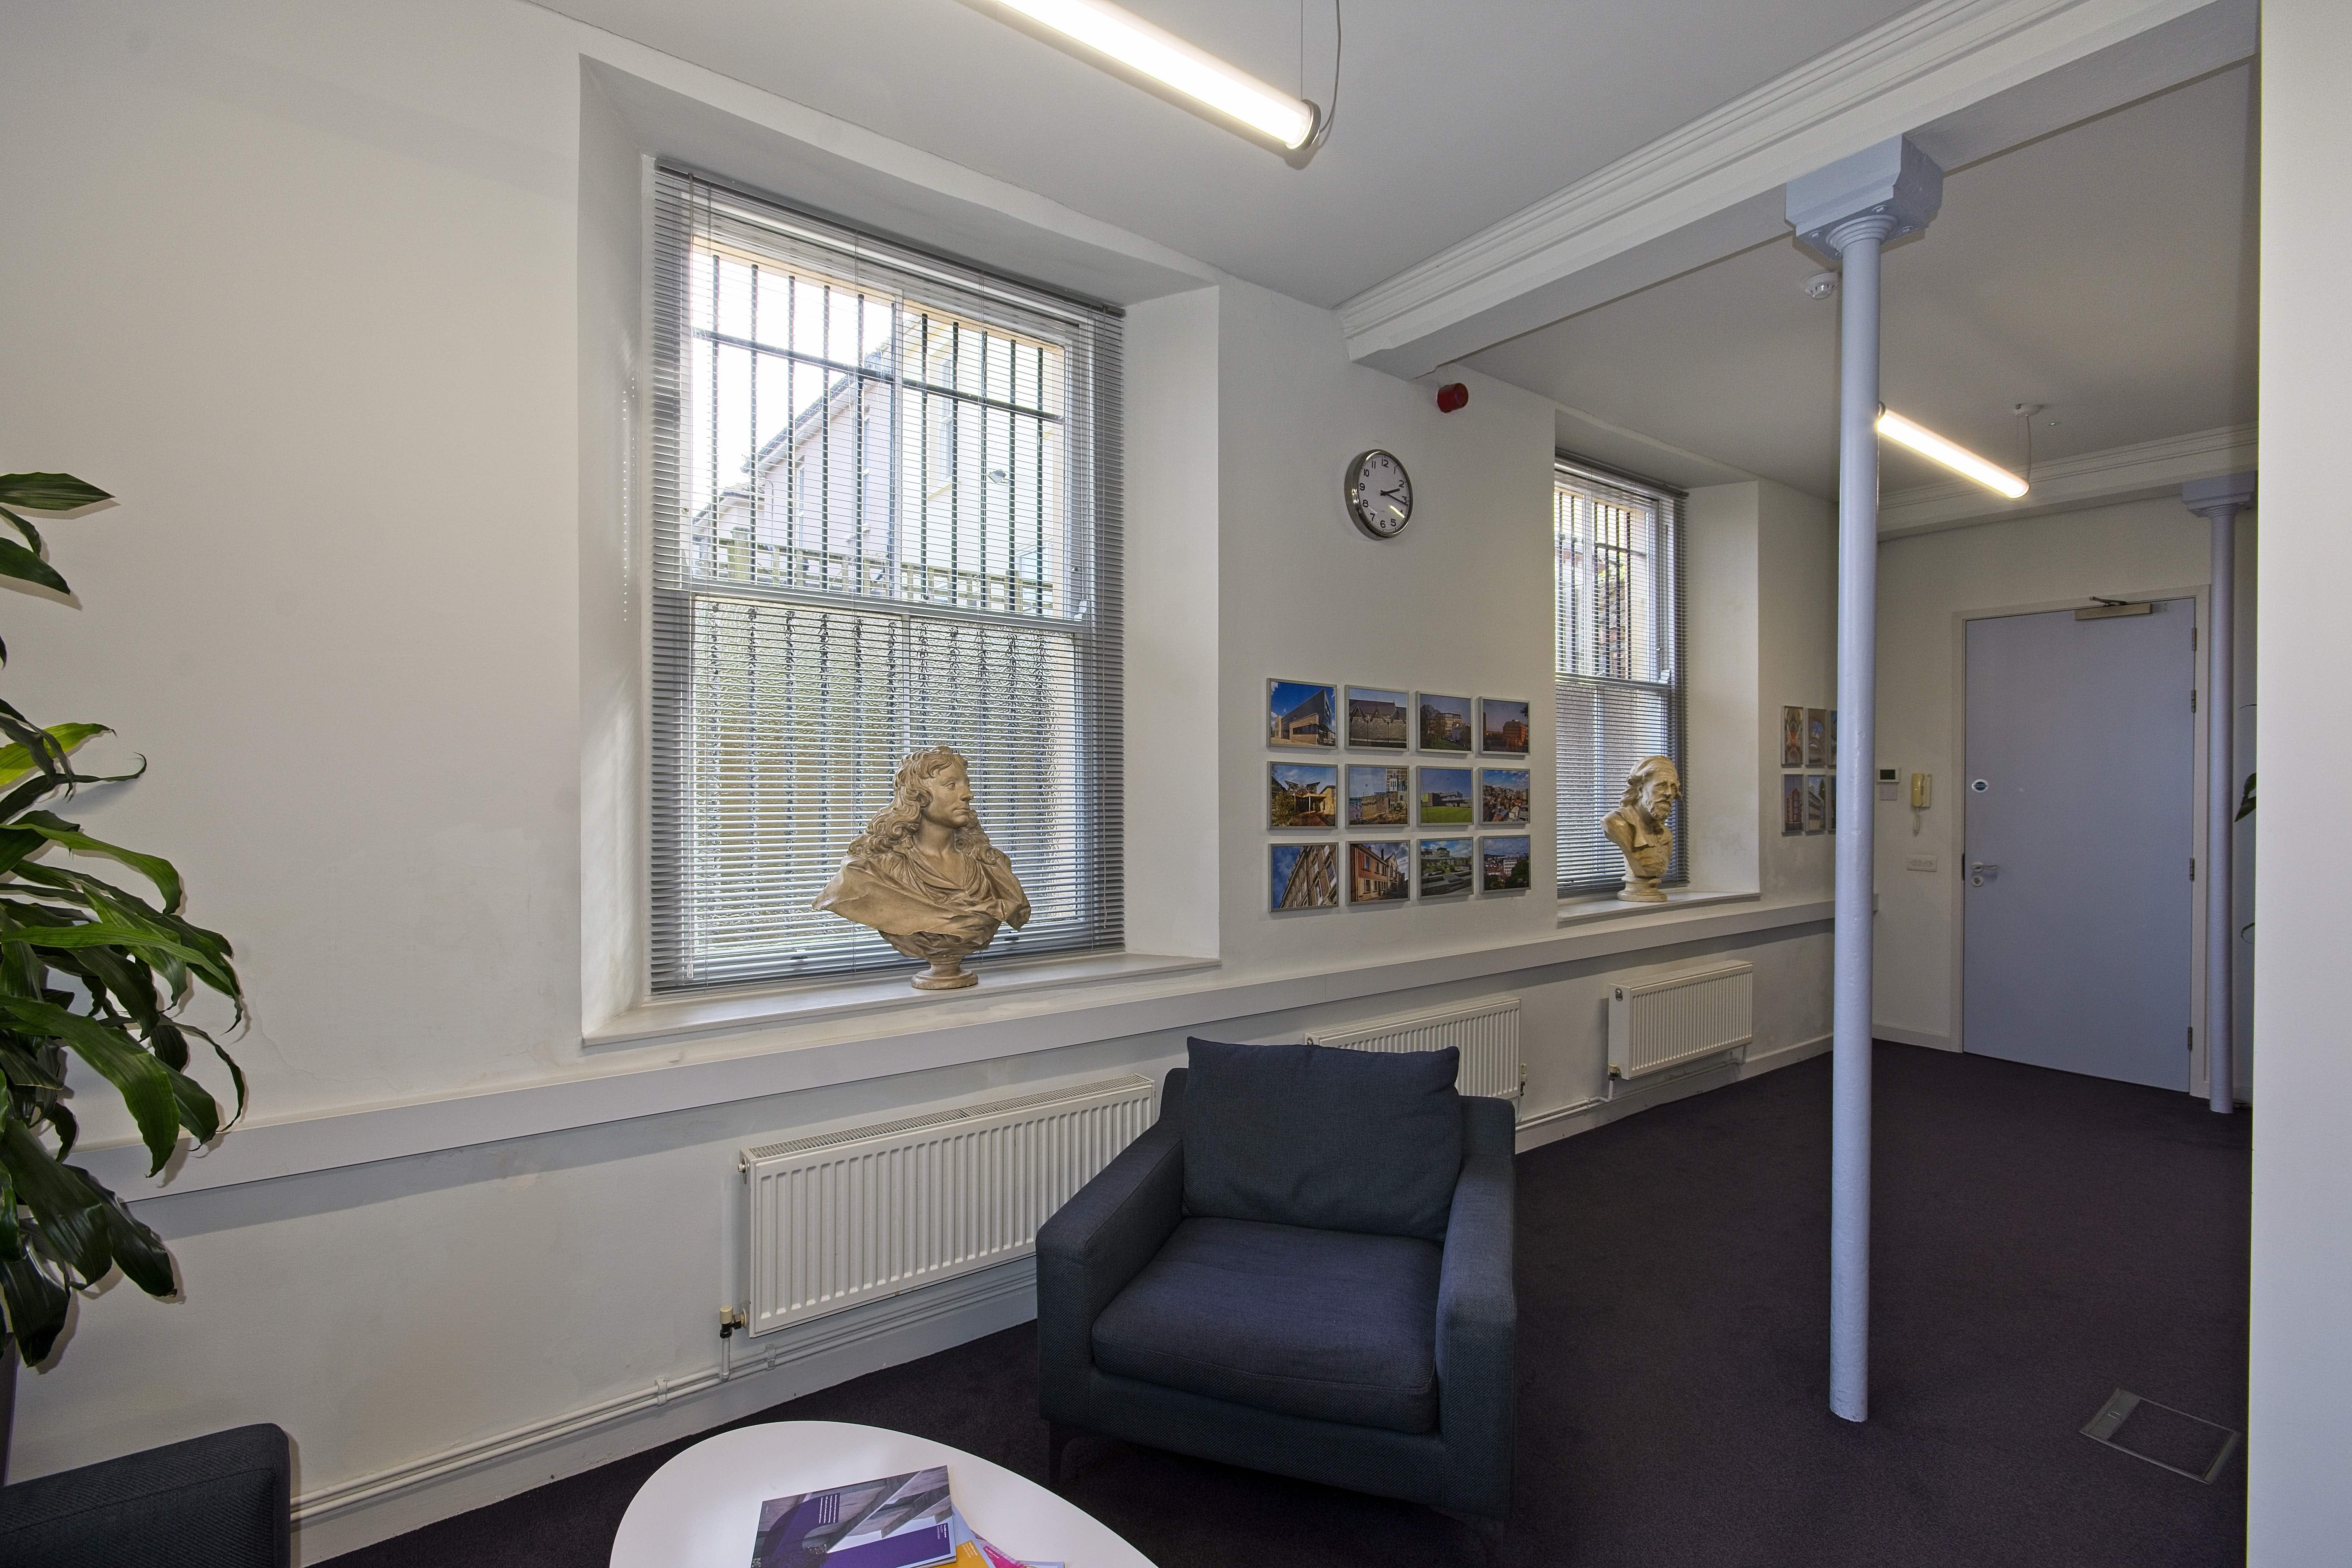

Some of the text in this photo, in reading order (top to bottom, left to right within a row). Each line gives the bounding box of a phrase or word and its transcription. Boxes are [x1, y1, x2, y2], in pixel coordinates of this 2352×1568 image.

[1381, 458, 1388, 468] 12
[1363, 468, 1369, 477] 10
[1380, 520, 1386, 528] 6
